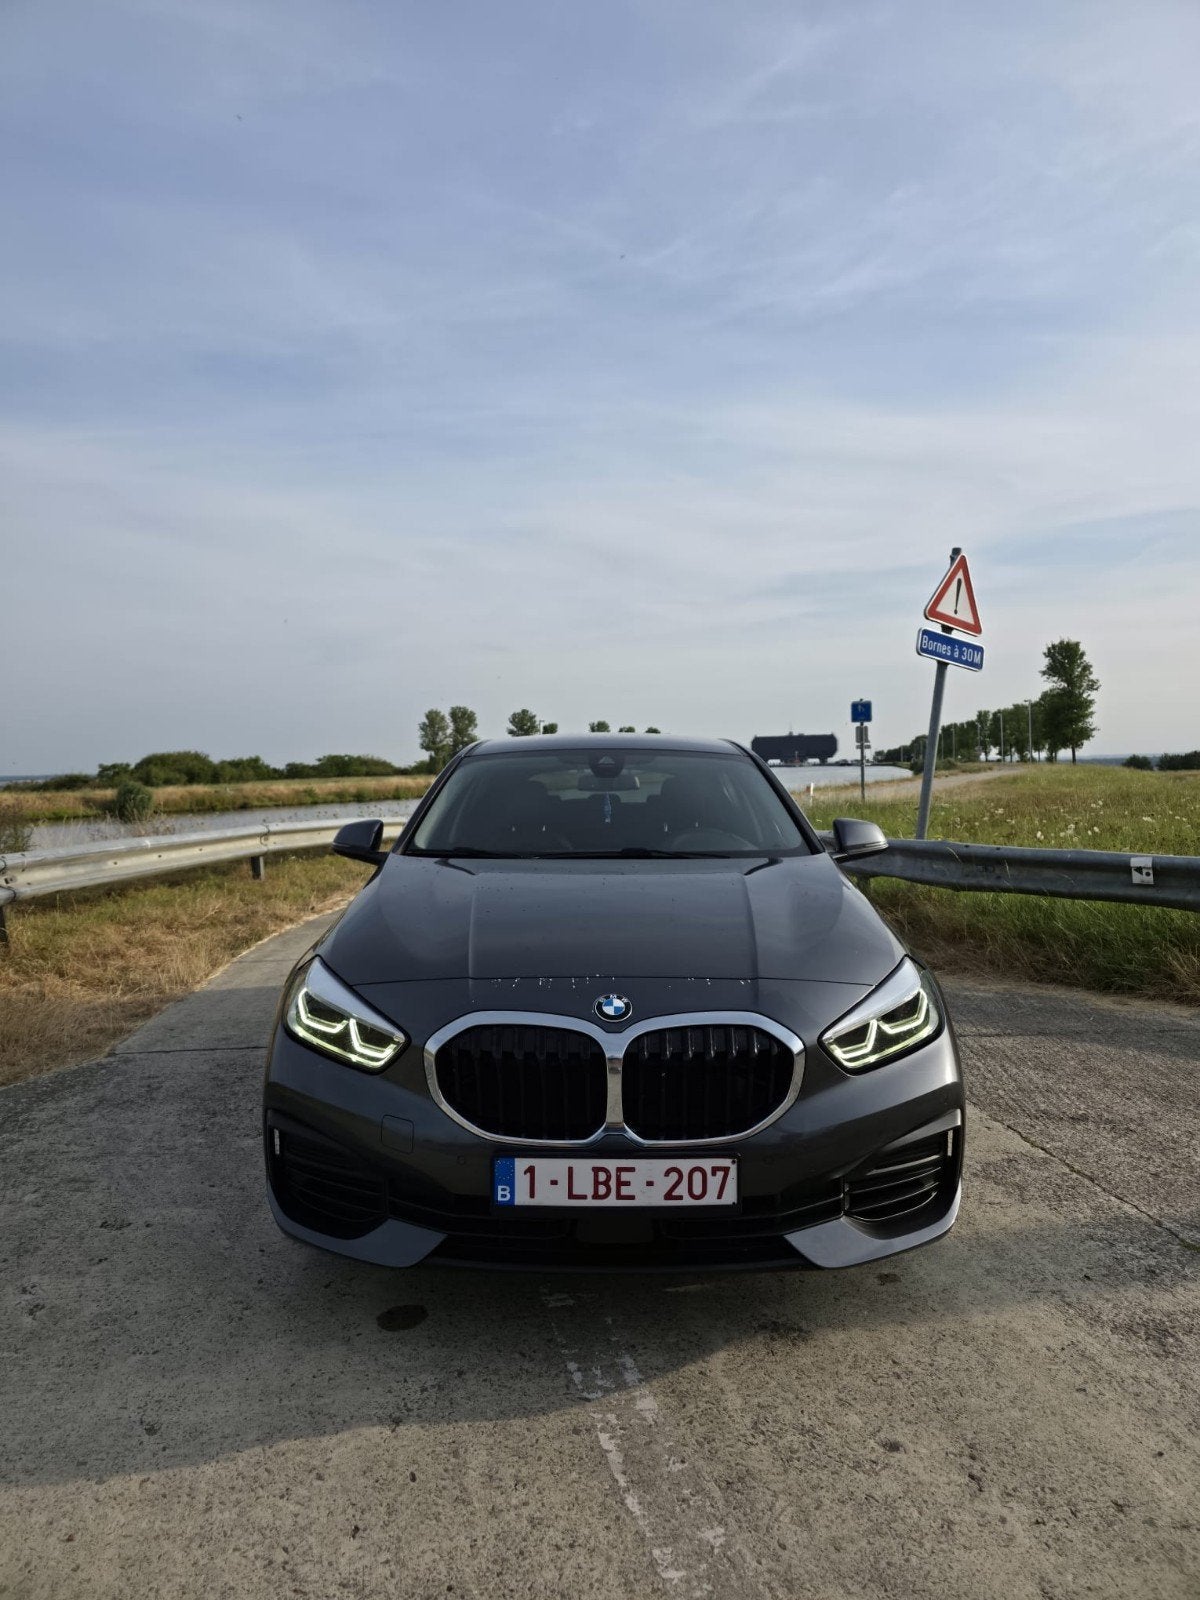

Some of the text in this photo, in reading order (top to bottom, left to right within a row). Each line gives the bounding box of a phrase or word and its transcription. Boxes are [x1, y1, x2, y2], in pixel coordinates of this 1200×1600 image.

[922, 635, 951, 656] Bornes
[953, 645, 959, 658] à
[497, 1185, 511, 1202] B
[523, 1165, 731, 1201] 1-LBE-207
